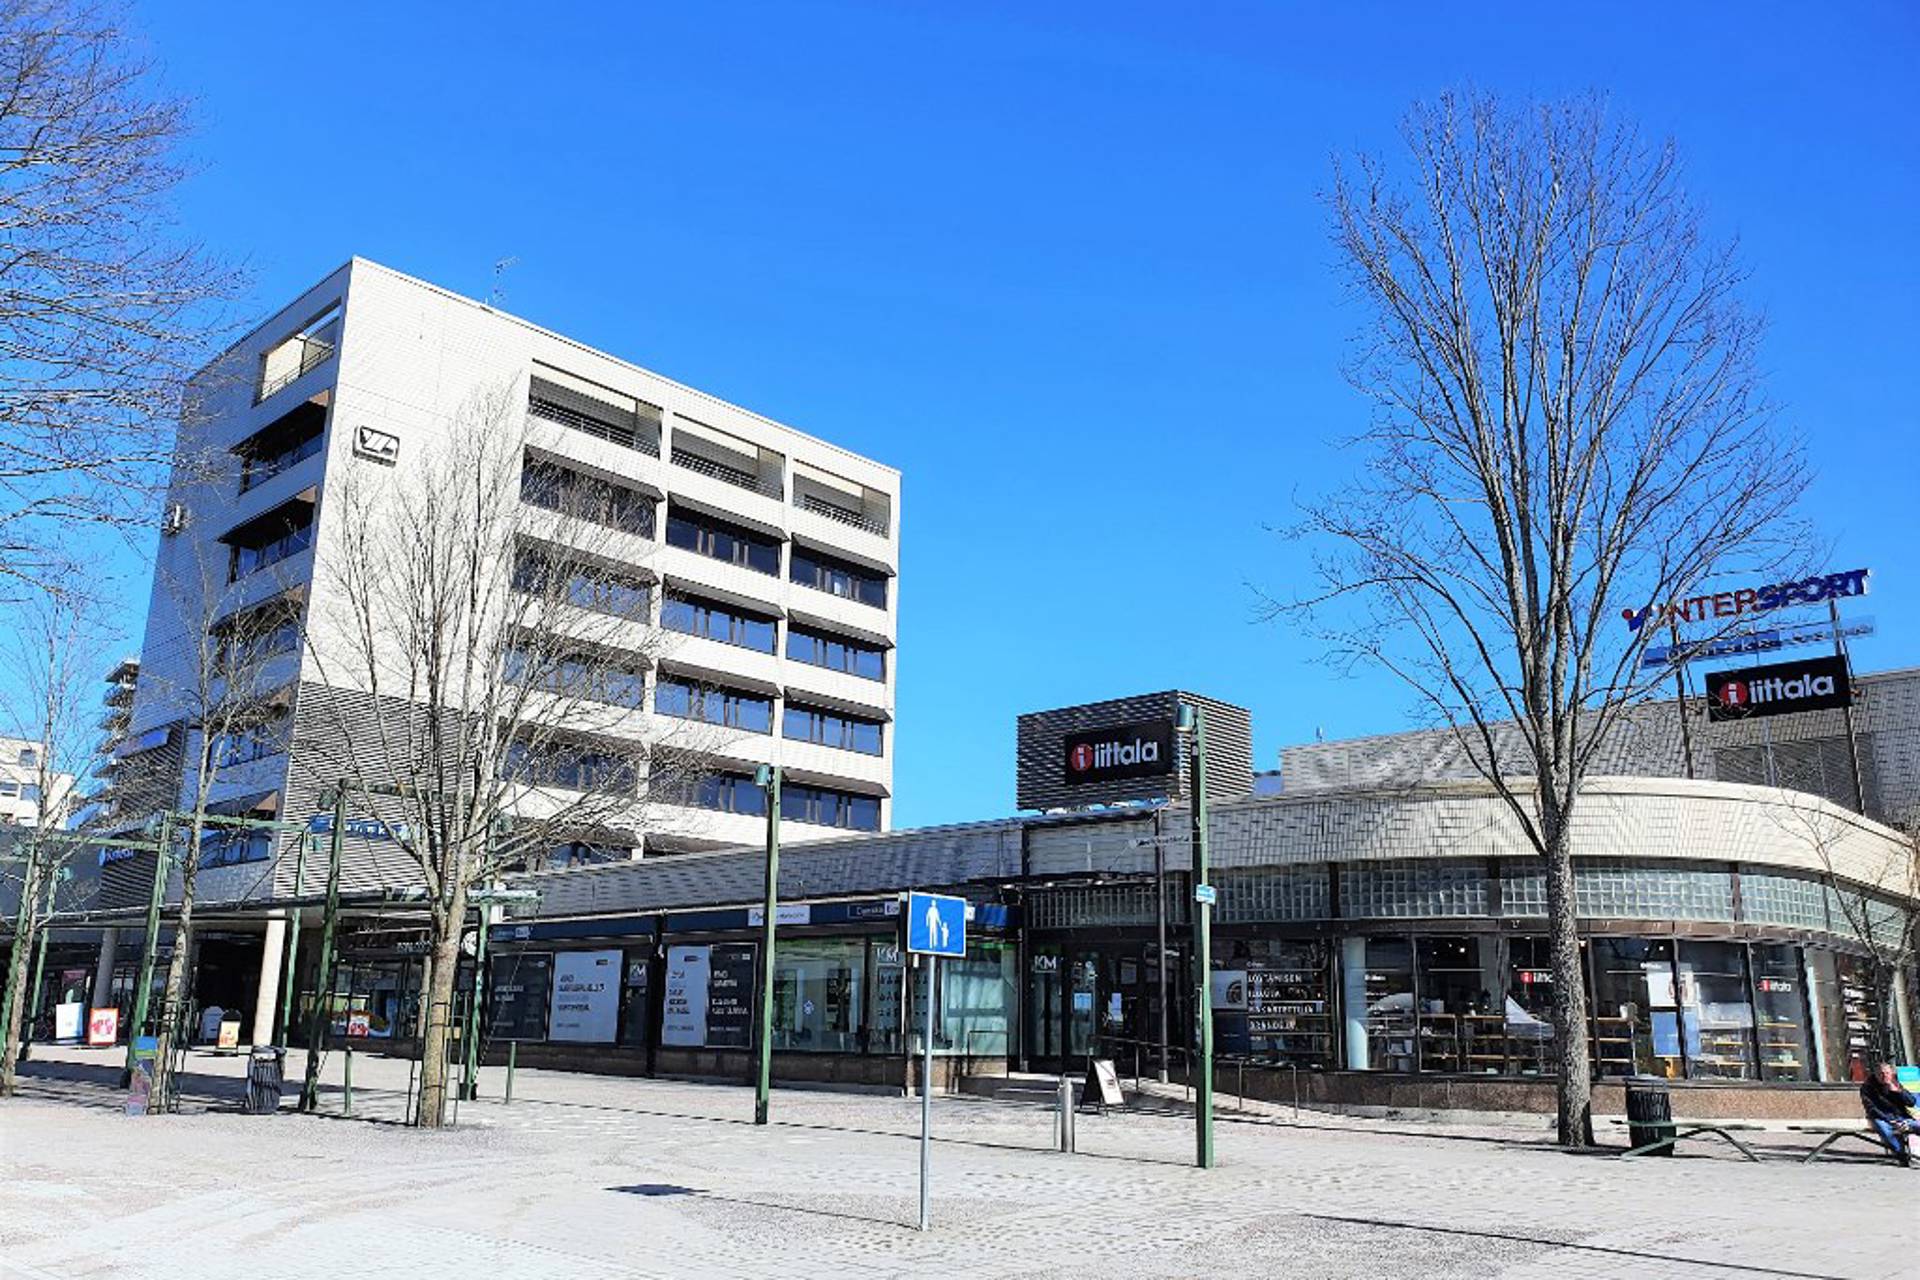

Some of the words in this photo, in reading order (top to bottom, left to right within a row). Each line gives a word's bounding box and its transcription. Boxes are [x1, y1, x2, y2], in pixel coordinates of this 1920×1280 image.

[1658, 568, 1871, 623] INTERSPORT
[1748, 673, 1836, 704] iittala
[1094, 738, 1158, 769] iittala
